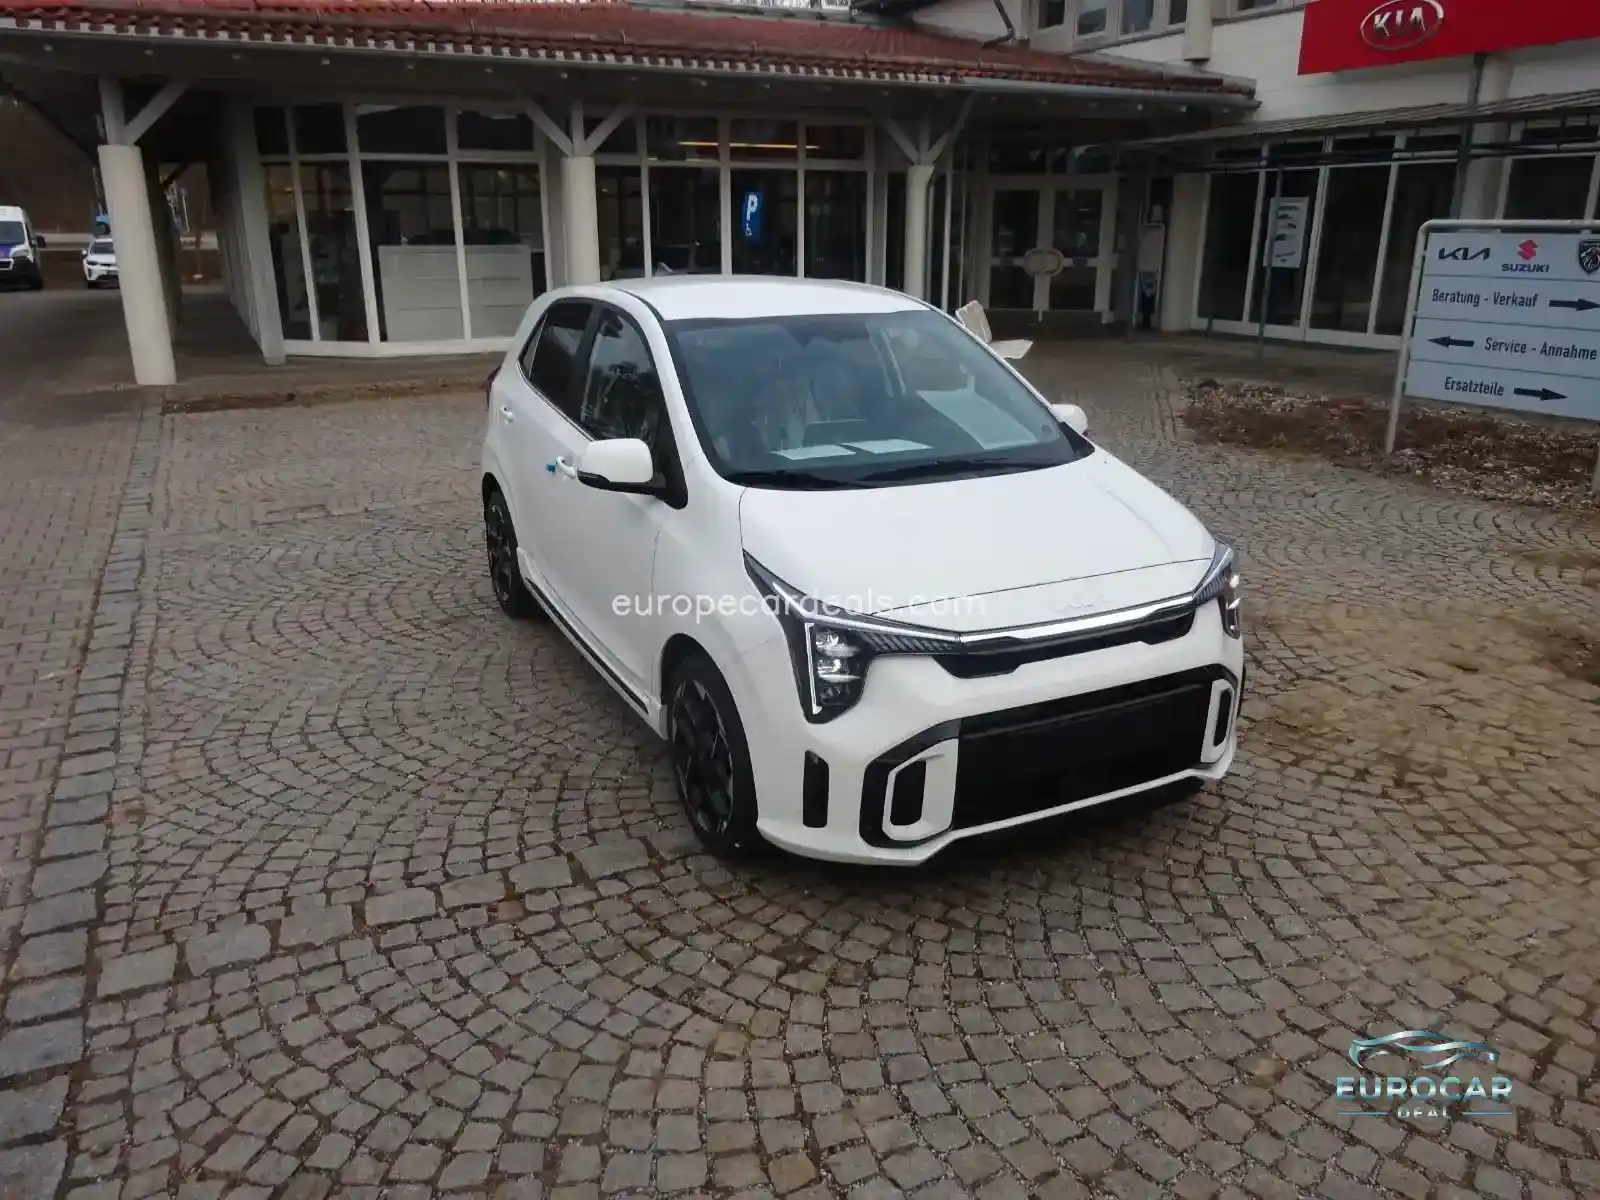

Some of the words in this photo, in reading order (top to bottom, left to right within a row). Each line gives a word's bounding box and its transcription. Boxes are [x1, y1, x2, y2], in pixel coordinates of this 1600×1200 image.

[1373, 7, 1426, 36] KIA
[746, 194, 758, 221] P
[1438, 247, 1491, 260] KIA
[1501, 263, 1550, 273] SUZUKI
[1431, 288, 1481, 307] Beratung
[1493, 292, 1538, 308] Verkauf
[1484, 336, 1527, 354] Service
[1540, 341, 1597, 360] Annahme
[1444, 376, 1505, 397] Ersatzteile
